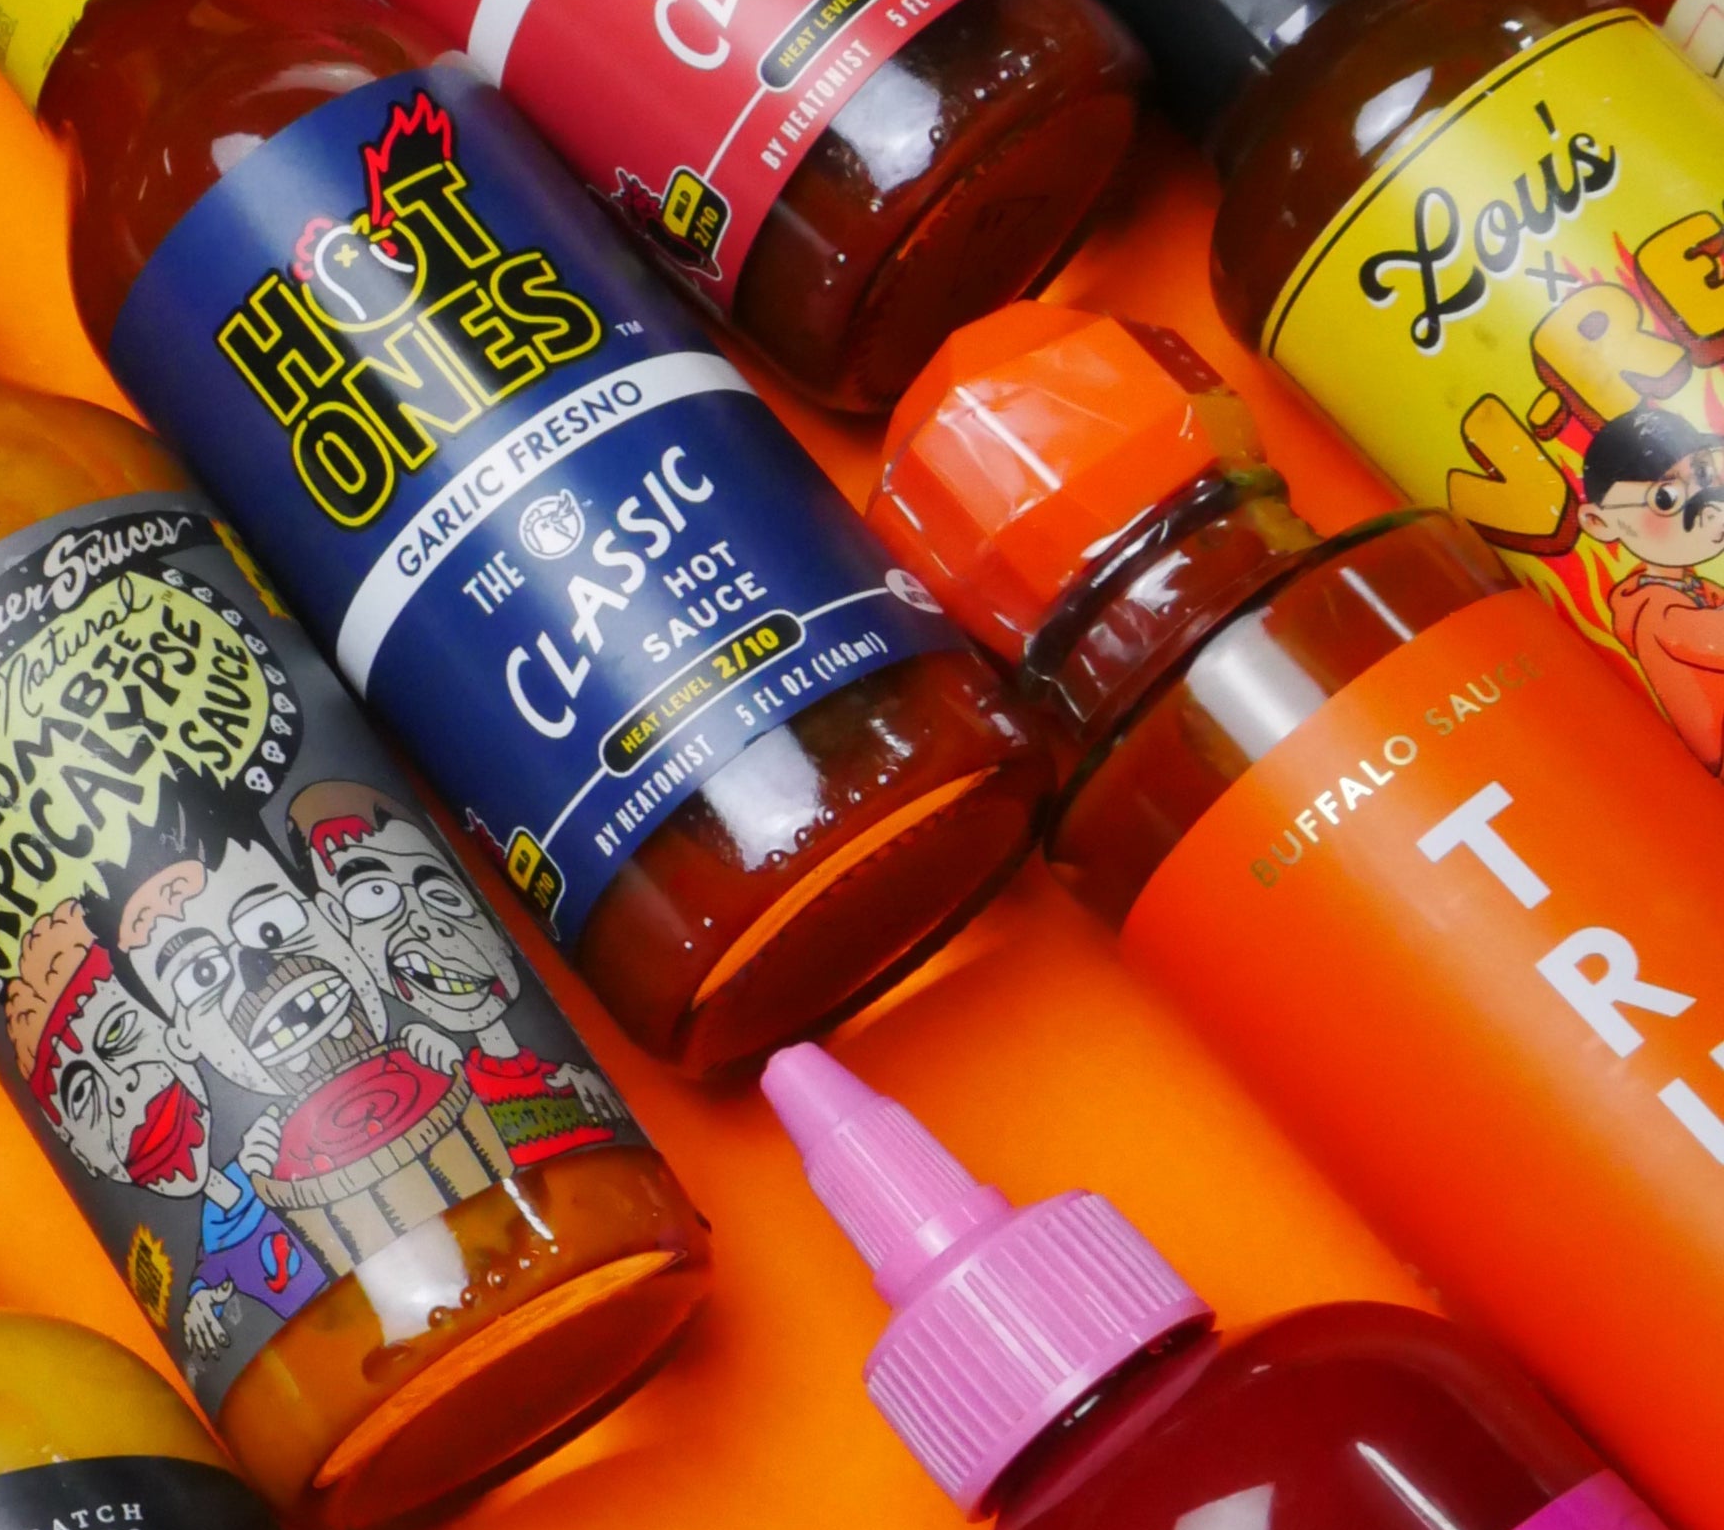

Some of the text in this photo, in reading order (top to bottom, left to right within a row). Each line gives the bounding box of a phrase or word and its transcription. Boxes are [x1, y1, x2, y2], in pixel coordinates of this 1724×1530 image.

[778, 28, 817, 69] HEAT
[780, 39, 872, 144] HEATONIST
[217, 160, 504, 426] HOT
[293, 250, 602, 532] ONES
[396, 380, 644, 581] GARLIC FRESNO
[463, 551, 526, 616] THE
[505, 445, 716, 743] CLASSIC
[642, 571, 768, 663] SAUCE
[663, 541, 738, 599] HOT
[183, 638, 251, 773] SAUCE
[620, 627, 780, 754] HEAT LEVEL 2/10
[754, 631, 889, 714] FL OZ (148ml)
[616, 733, 717, 833] HEATONIST
[1249, 652, 1544, 889] BUFFALO SAUCE
